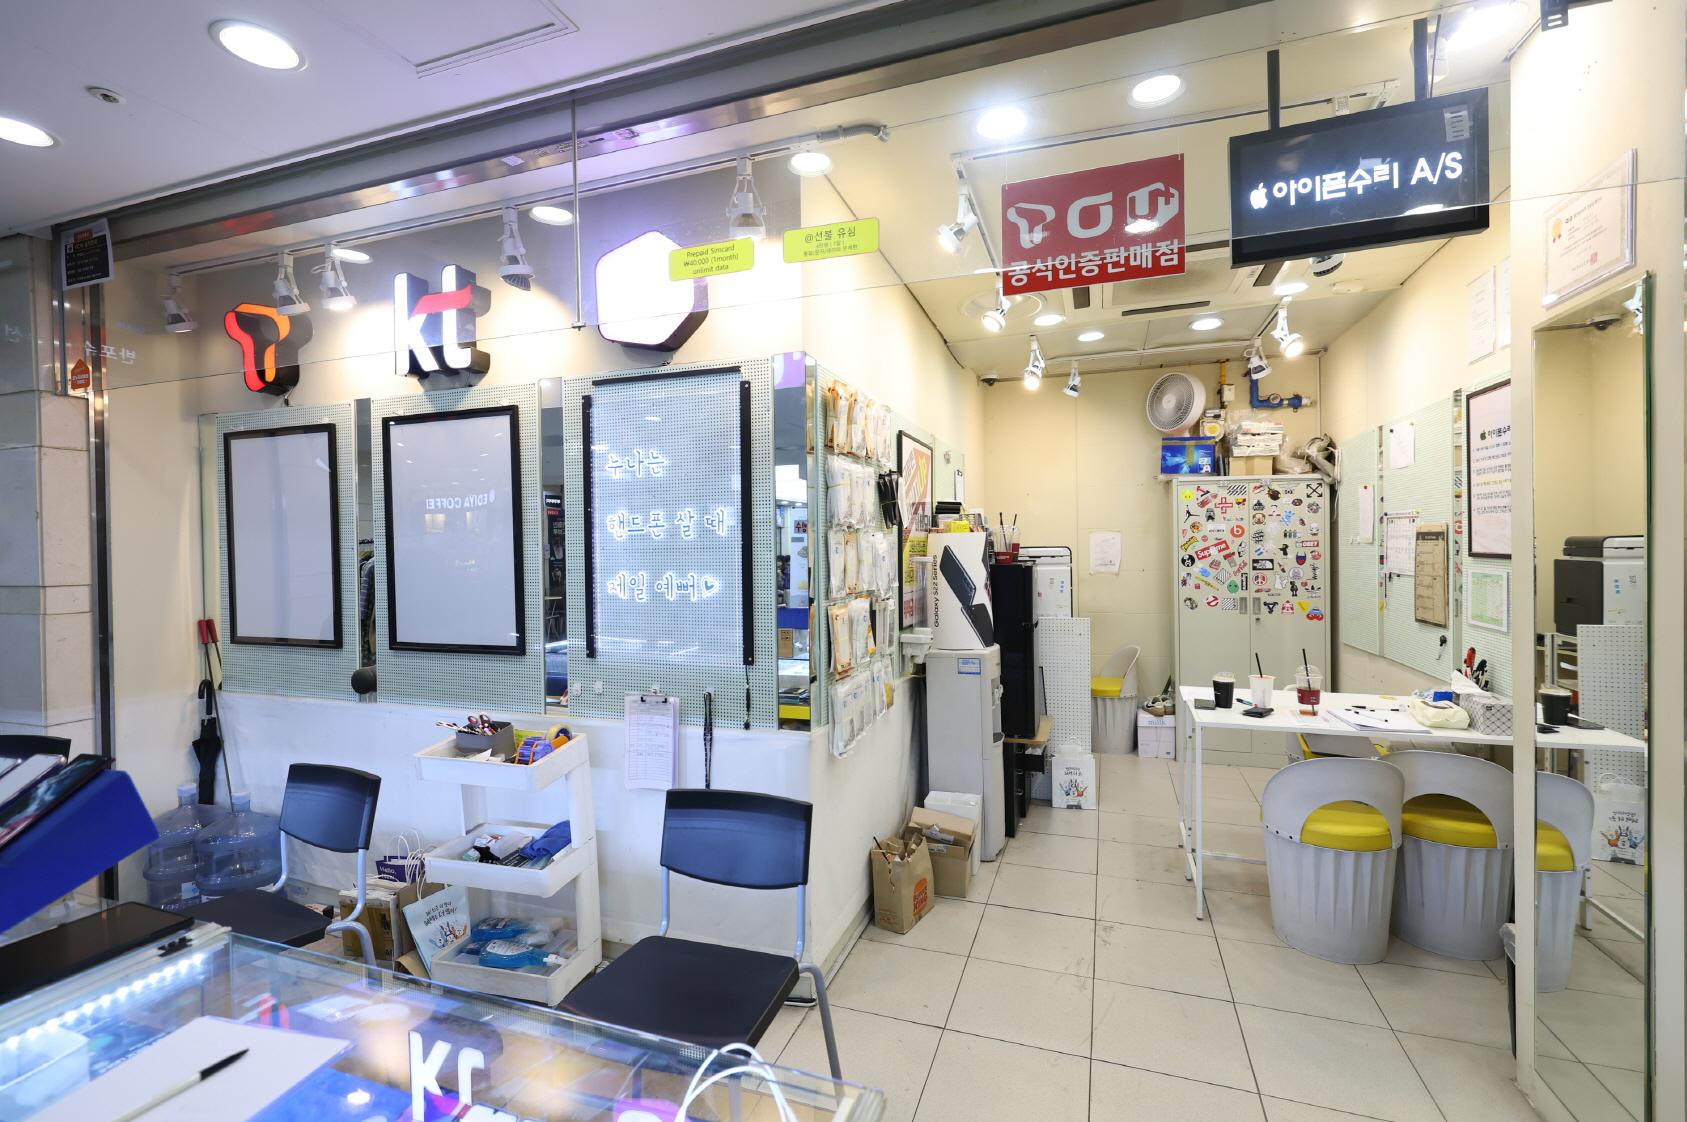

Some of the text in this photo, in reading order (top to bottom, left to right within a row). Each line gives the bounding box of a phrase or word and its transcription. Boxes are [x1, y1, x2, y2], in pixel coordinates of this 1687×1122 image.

[1272, 151, 1464, 206] 아이폰수리 A/S
[804, 226, 856, 244] @선불 유심
[686, 243, 735, 258] Prepaid Simcard
[1008, 239, 1180, 287] 공식인증판매점
[715, 264, 729, 272] data
[393, 264, 473, 376] kt
[607, 450, 665, 477] 누나는
[607, 509, 726, 538] 핸드폰 살 때
[608, 573, 696, 601] 제일 예뻐
